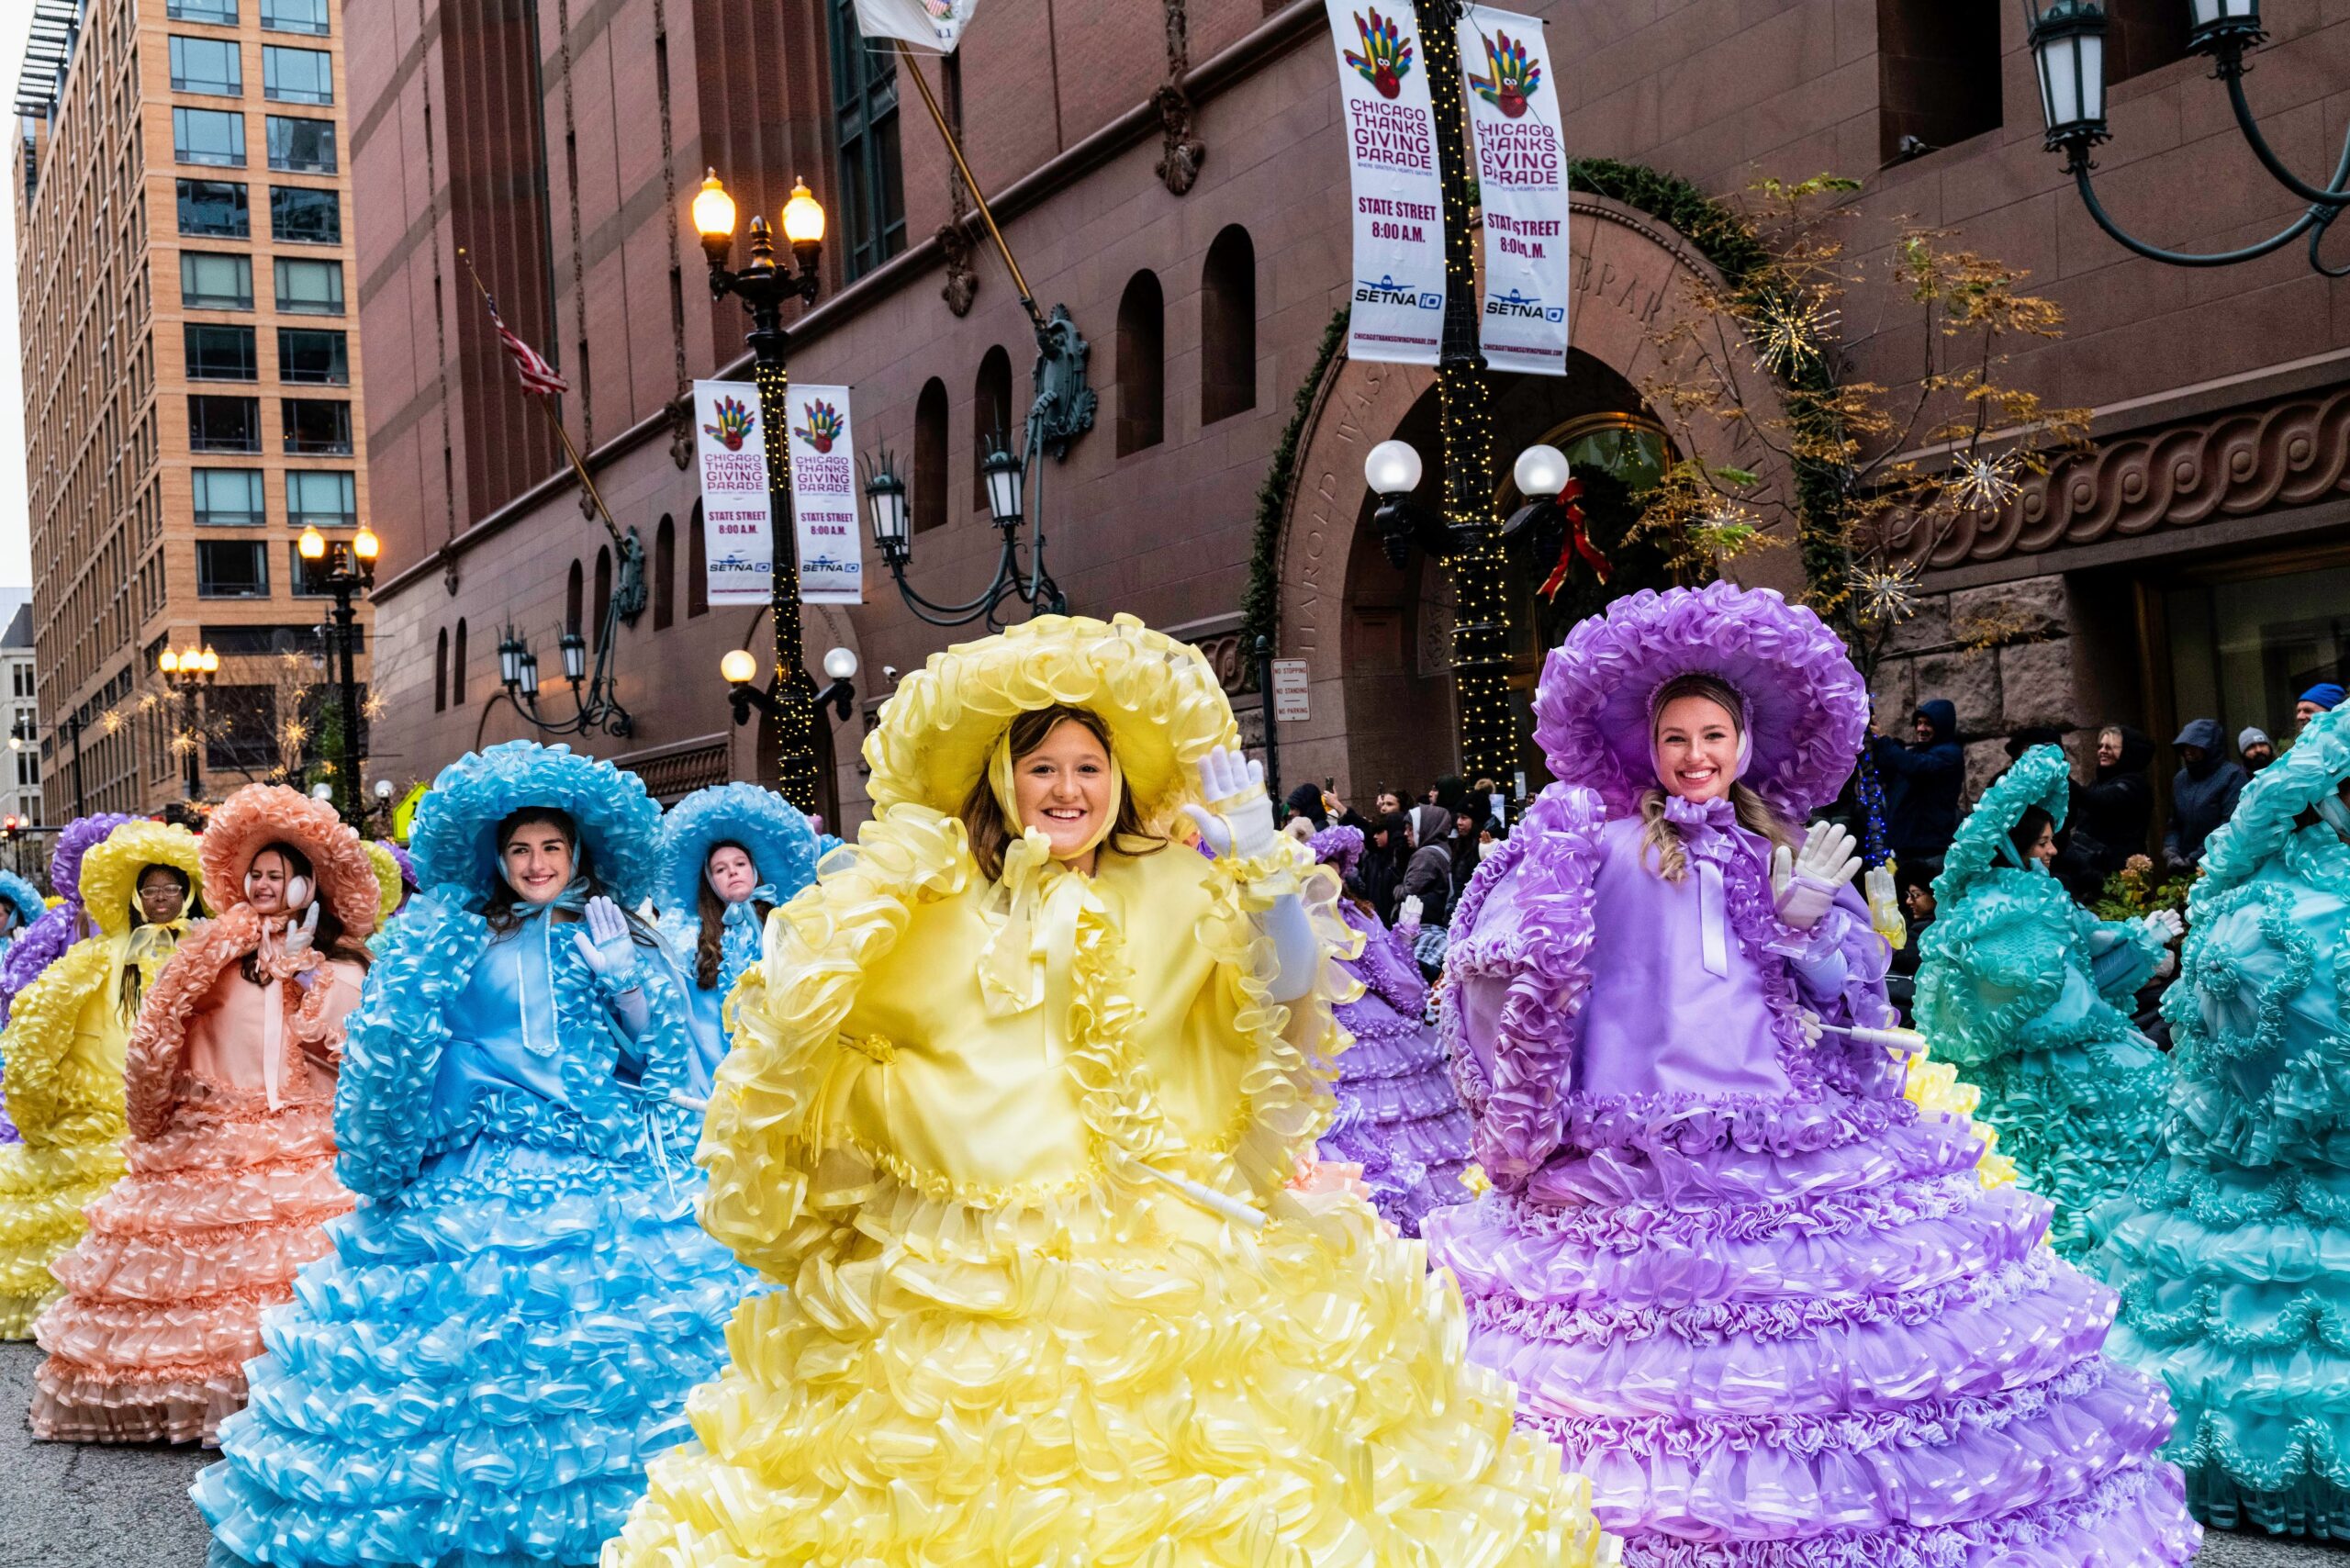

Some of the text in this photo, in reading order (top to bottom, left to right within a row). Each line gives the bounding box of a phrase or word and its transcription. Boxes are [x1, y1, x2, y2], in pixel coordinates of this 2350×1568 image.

[1350, 99, 1426, 121] CHICAGO
[1351, 113, 1428, 136] THANKS
[1355, 129, 1430, 153] GIVING
[1357, 146, 1432, 169] PARADE
[1481, 147, 1558, 169] GVING
[1359, 196, 1436, 220] STATE STREET
[1488, 213, 1561, 236] STAT STREET
[1372, 221, 1426, 242] 8:00 A.M.
[1355, 289, 1416, 306] SETNA
[1485, 302, 1543, 319] SETNA
[705, 454, 761, 462] CHICAGO
[795, 456, 849, 465] CHICAGO
[705, 462, 762, 471] THANKS
[797, 464, 849, 474] THANKS
[706, 471, 763, 481] GIVING
[798, 473, 850, 484] GIVING
[707, 482, 764, 490] PARADE
[799, 483, 850, 493] PARADE
[709, 510, 767, 521] STATE STREET
[800, 512, 854, 522] STATE STREET
[719, 524, 758, 534] 8:00 A.M.
[811, 525, 846, 535] 8:00 A.M.
[1299, 471, 1337, 650] HAROLD
[710, 564, 754, 572] SETNA
[802, 564, 843, 572] SETNA
